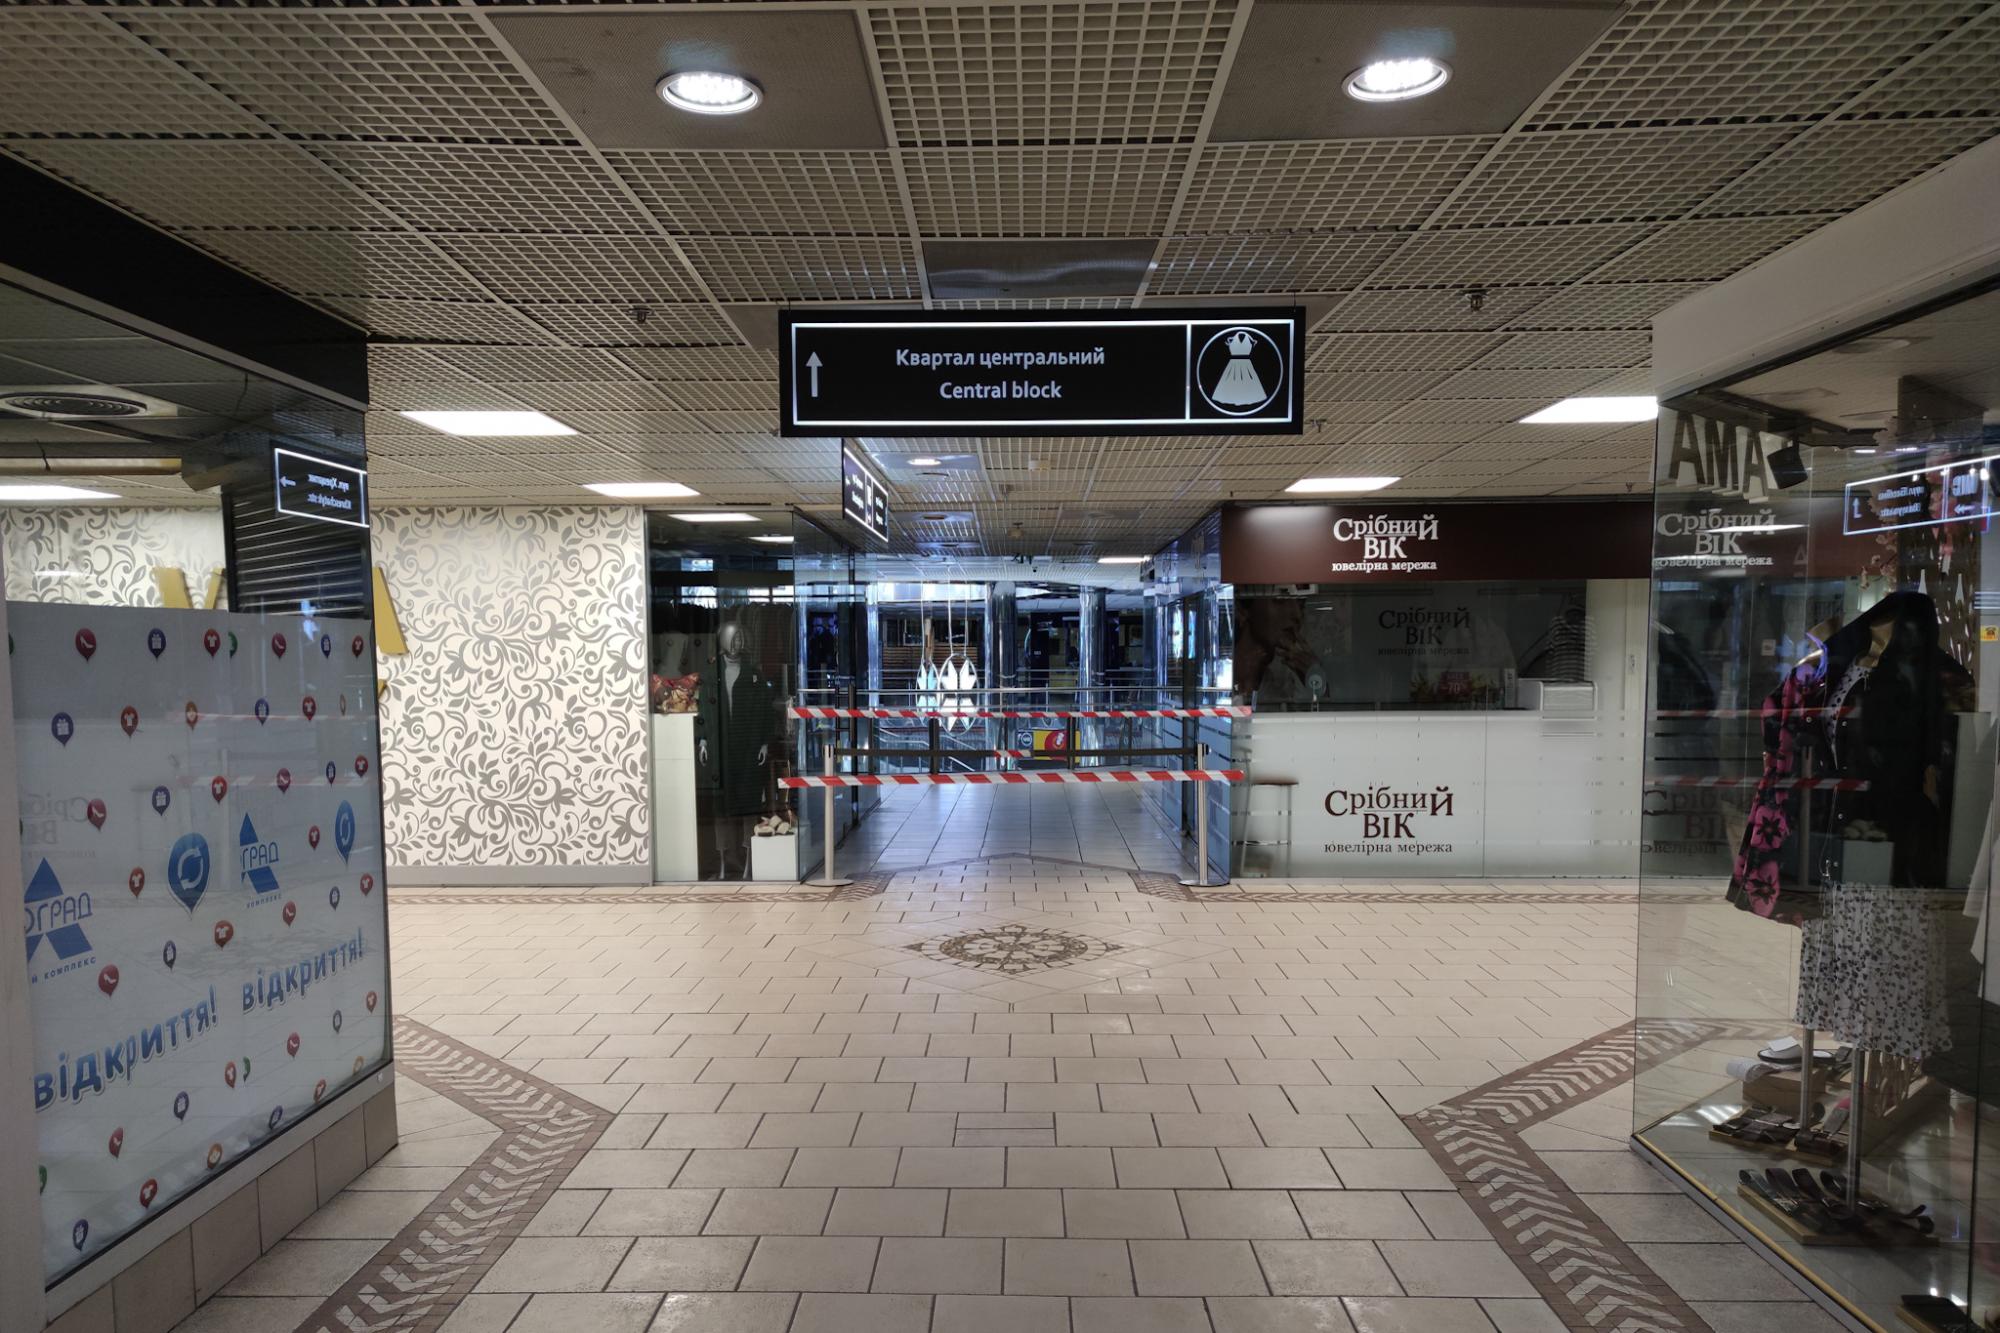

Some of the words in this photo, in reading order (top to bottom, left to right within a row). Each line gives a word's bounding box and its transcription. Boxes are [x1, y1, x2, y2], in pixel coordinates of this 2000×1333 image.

[896, 349, 975, 371] Квартал
[979, 346, 1105, 370] центральний
[939, 381, 1007, 399] Central
[1012, 381, 1063, 398] block
[1332, 560, 1388, 573] ювелірна
[1391, 561, 1438, 573] мережа
[1324, 840, 1392, 855] ювелірна
[1397, 841, 1453, 855] мережа
[242, 926, 363, 1012] відкриття!
[33, 984, 218, 1110] відкриття!
